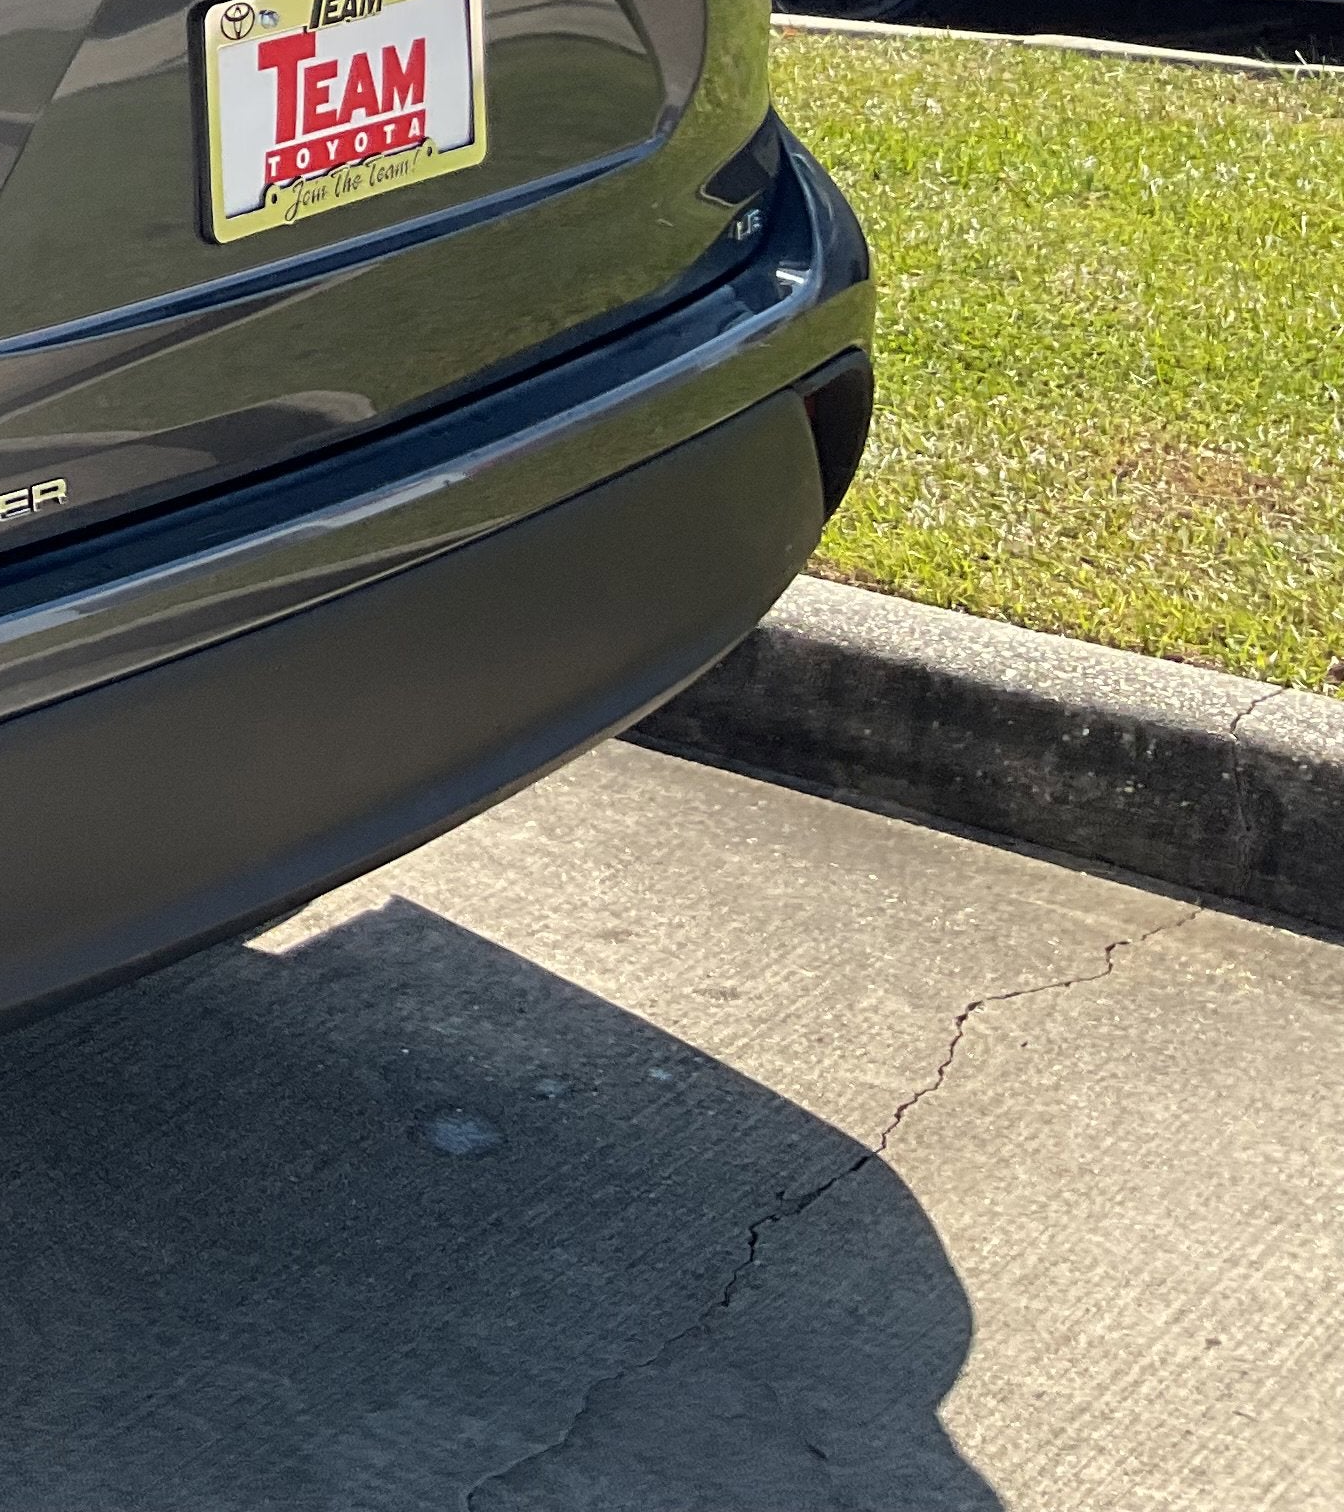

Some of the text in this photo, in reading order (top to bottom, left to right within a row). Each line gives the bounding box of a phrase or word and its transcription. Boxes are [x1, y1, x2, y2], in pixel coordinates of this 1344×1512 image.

[257, 32, 426, 145] TEAM
[267, 117, 422, 177] TOYOTA
[284, 180, 326, 221] Join
[330, 166, 363, 198] The
